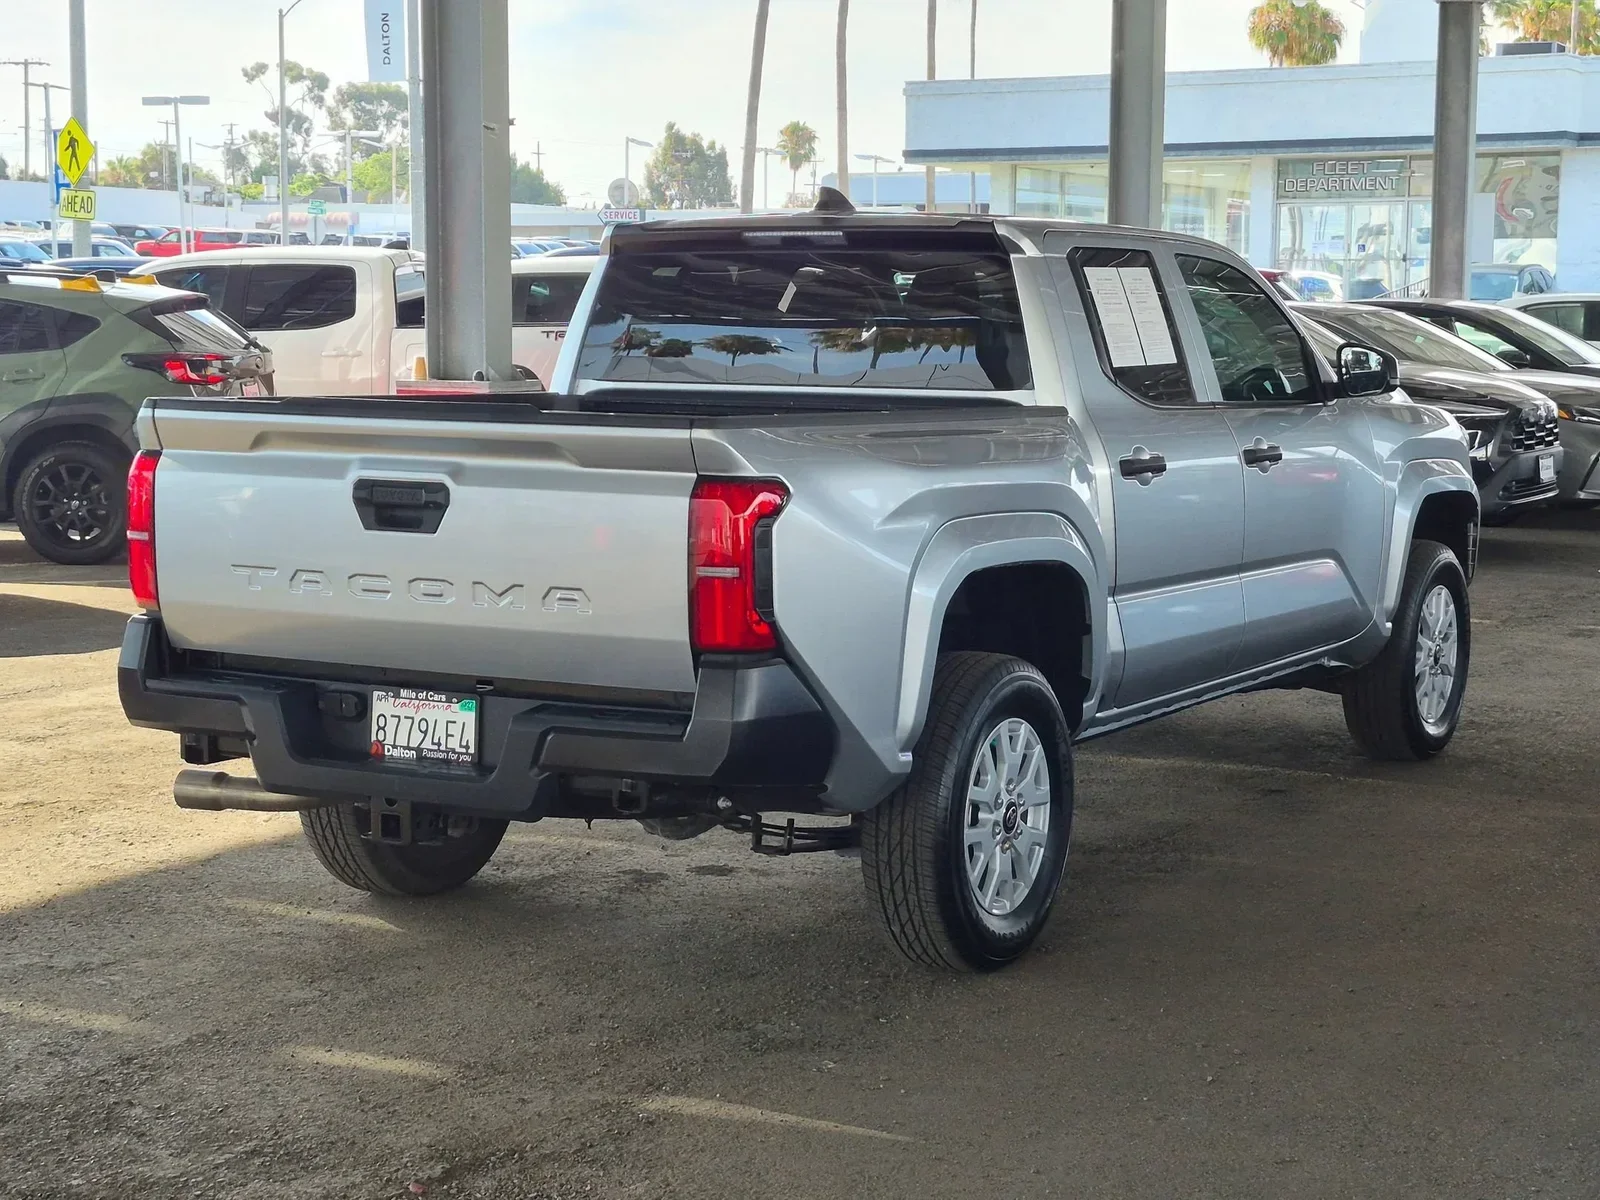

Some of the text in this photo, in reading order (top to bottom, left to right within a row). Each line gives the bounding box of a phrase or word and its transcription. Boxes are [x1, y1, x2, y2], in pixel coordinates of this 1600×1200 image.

[381, 13, 391, 65] DALTON
[1312, 161, 1372, 175] FLEET
[1284, 177, 1399, 192] DEPARTMENT
[62, 195, 93, 214] AHEAD
[603, 211, 638, 220] SERVICE
[541, 331, 567, 341] TR
[230, 564, 592, 614] TACOMA
[400, 689, 446, 702] Mile of Cars
[393, 698, 458, 715] California
[376, 713, 471, 753] 87794E4
[384, 745, 416, 758] Dalton
[422, 749, 472, 762] Passion for you
